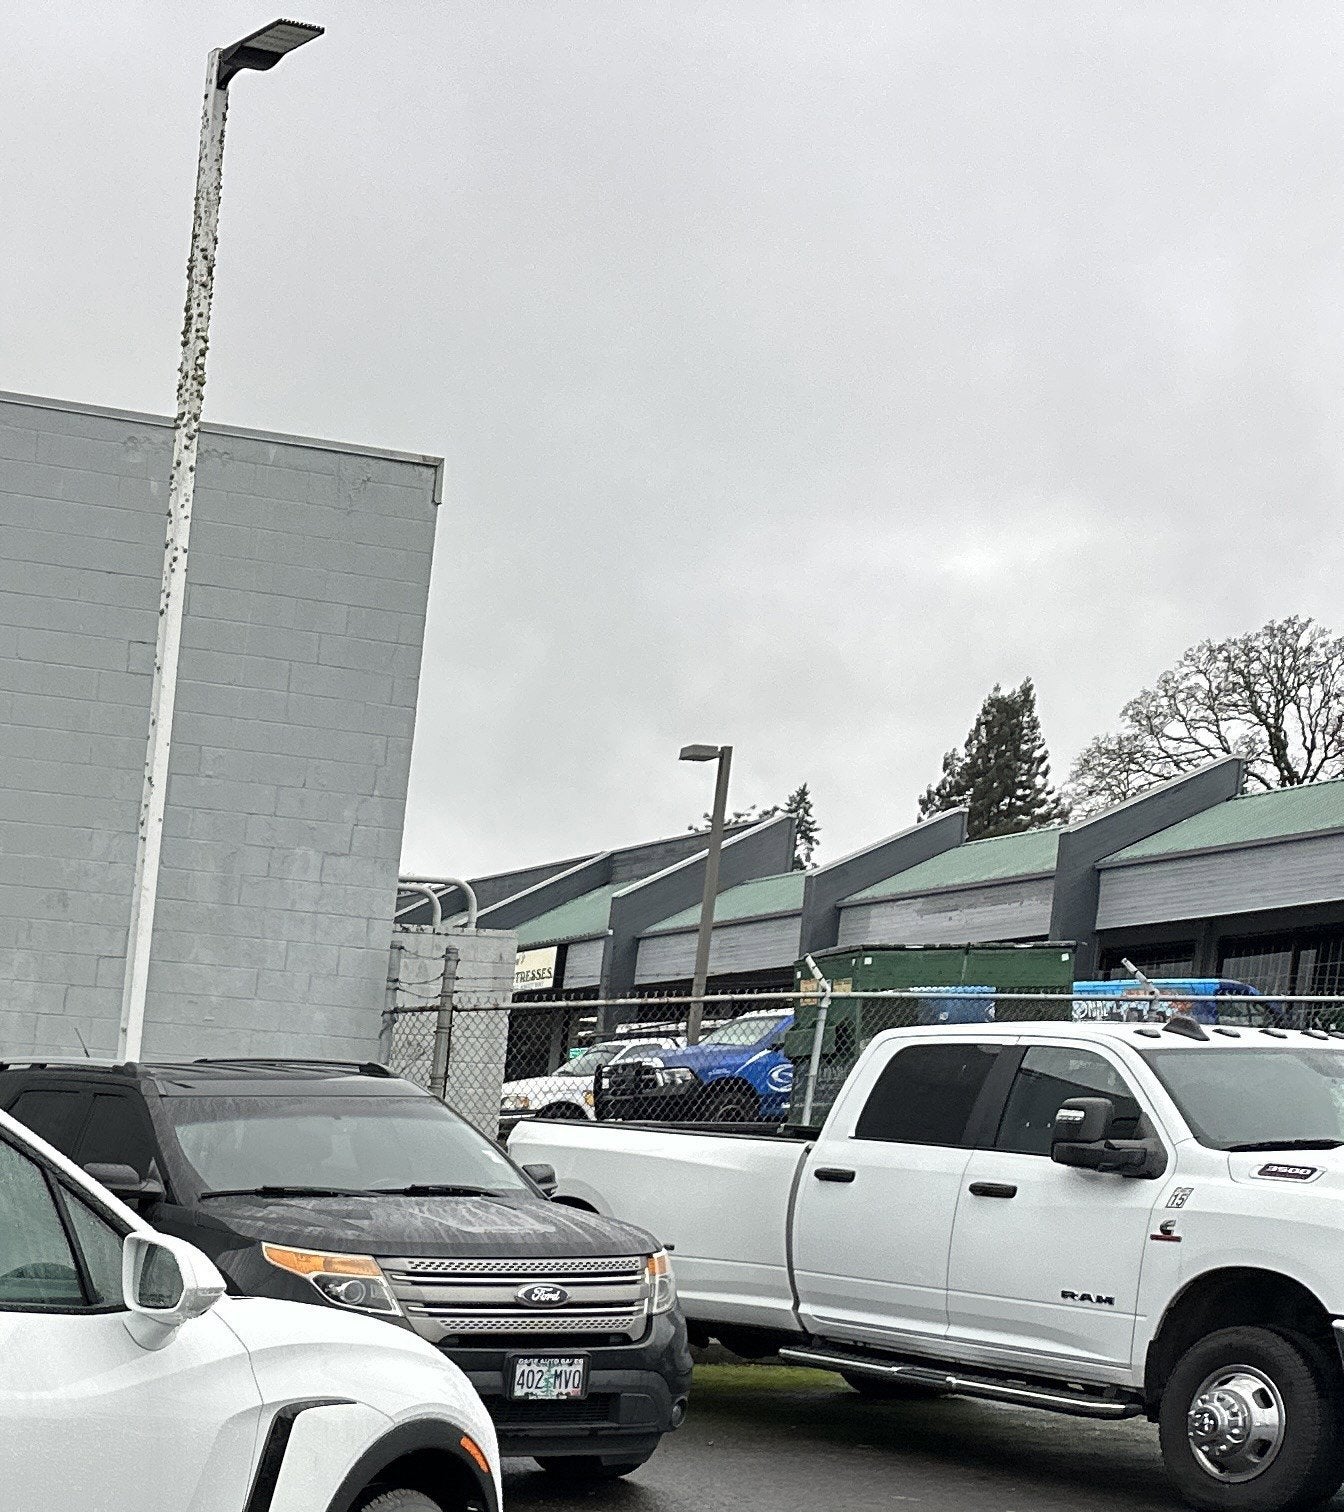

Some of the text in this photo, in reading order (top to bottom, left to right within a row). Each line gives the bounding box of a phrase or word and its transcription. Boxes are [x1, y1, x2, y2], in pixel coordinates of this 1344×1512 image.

[532, 1287, 561, 1301] Ford
[1061, 1290, 1115, 1306] RAM
[517, 1369, 545, 1389] 402
